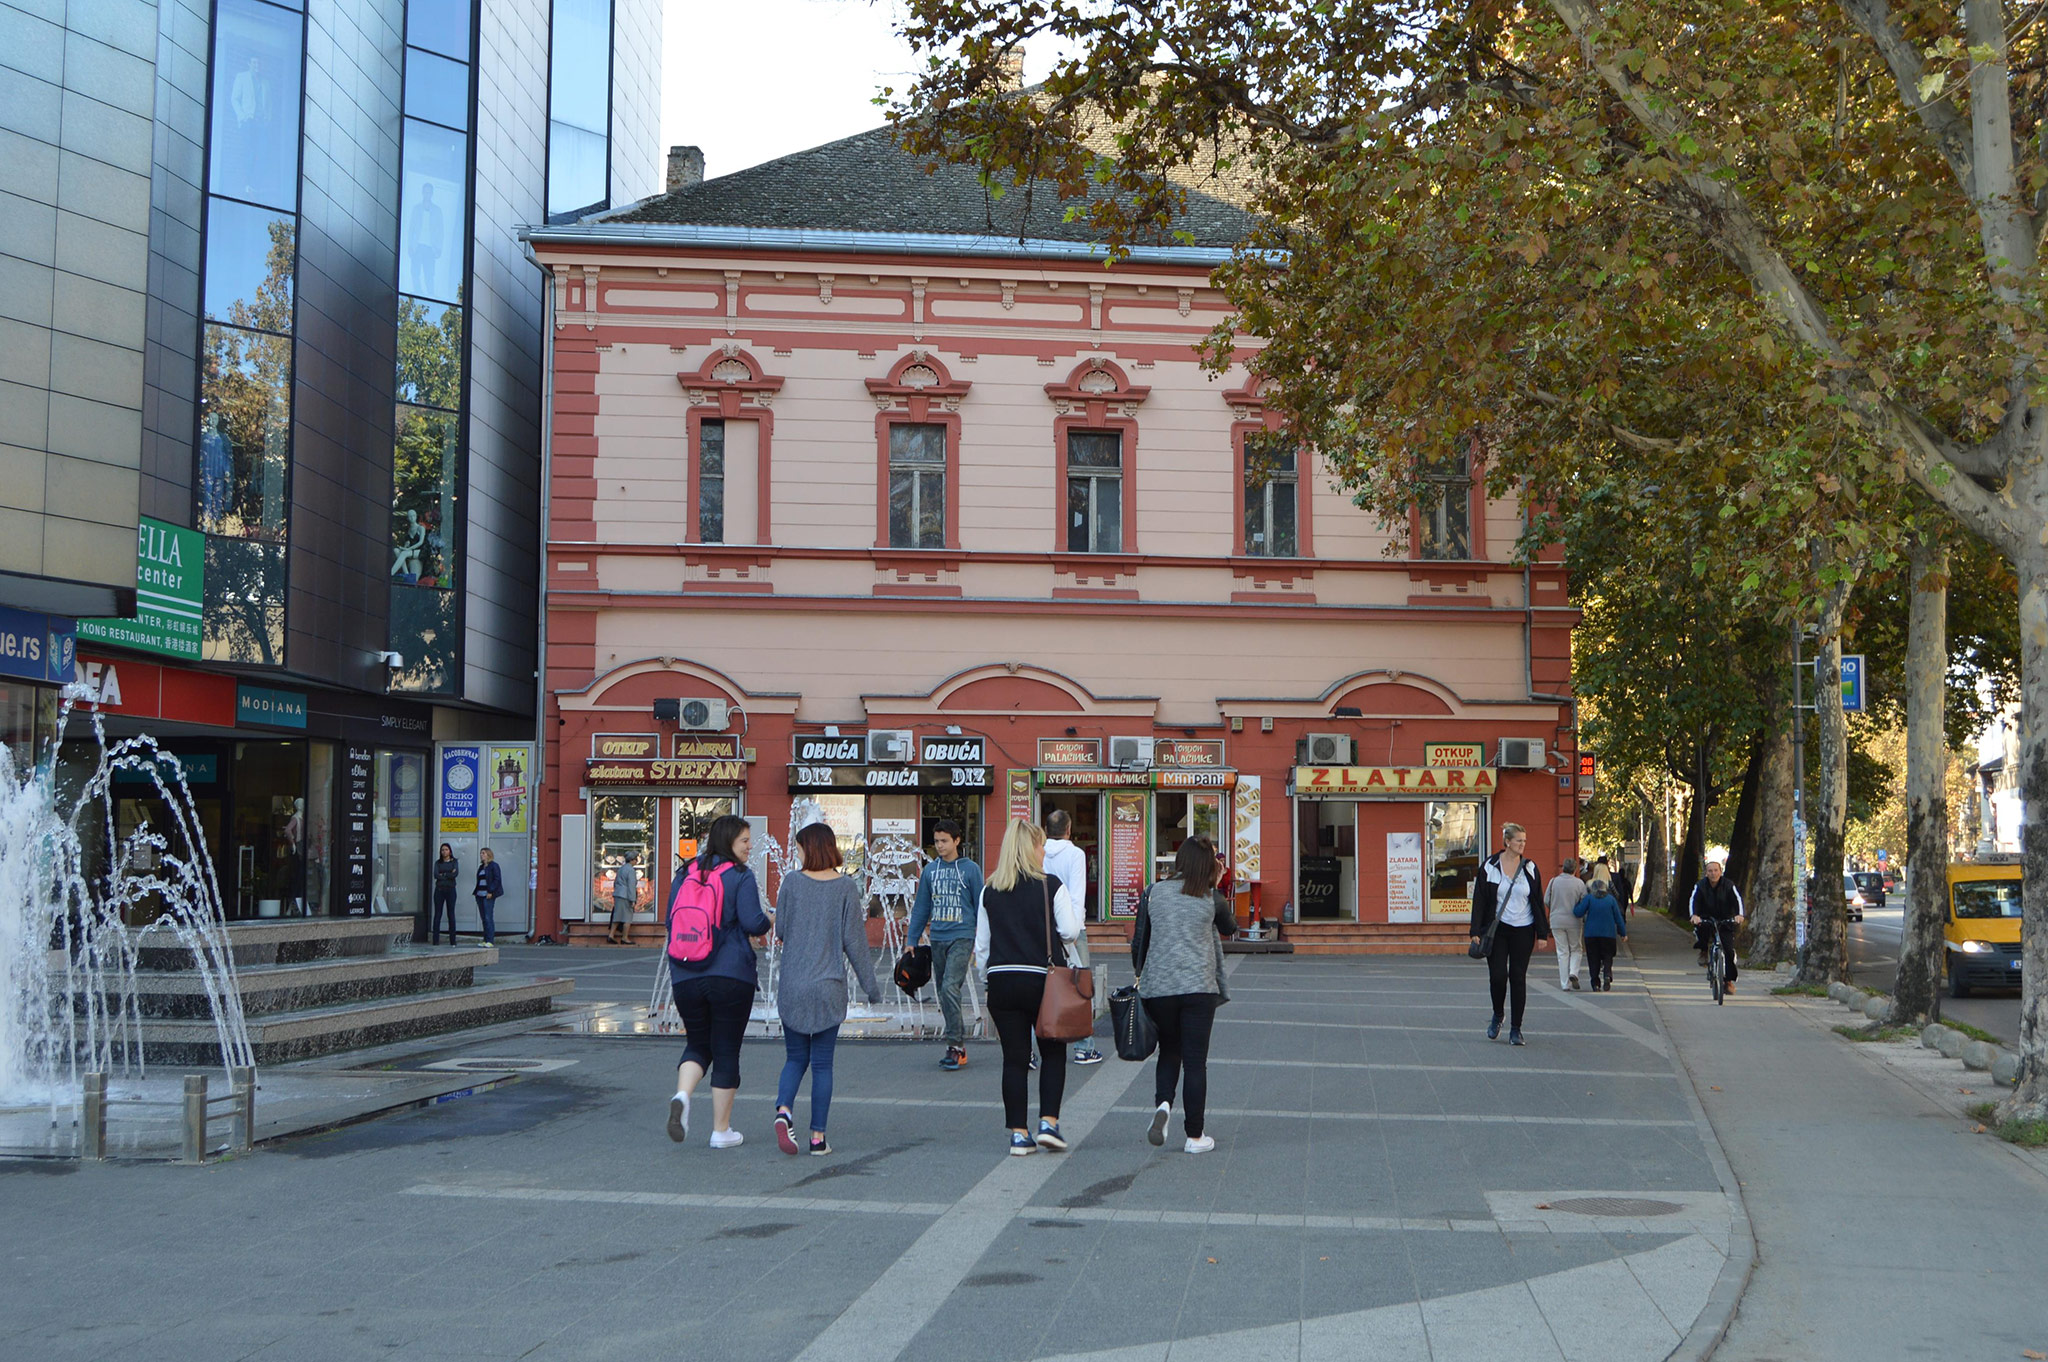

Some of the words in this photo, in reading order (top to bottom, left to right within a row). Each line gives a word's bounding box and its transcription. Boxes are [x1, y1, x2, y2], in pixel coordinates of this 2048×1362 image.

[138, 565, 182, 589] center
[82, 622, 107, 637] KONG
[109, 627, 163, 649] RESTAURANT,
[241, 695, 302, 715] MODIANA
[381, 715, 401, 729] SIMPLY
[402, 718, 427, 731] ELEGANT
[602, 742, 650, 755] OTKUP
[802, 740, 859, 759] OBUĆA
[924, 741, 980, 761] OBUĆA
[1056, 743, 1084, 753] LONDON
[1435, 748, 1473, 758] OTKUP
[589, 764, 645, 779] zlatara
[650, 761, 742, 779] STEFAN
[1432, 759, 1479, 767] ZAMENA
[797, 767, 833, 786] DIZ
[866, 768, 919, 786] OBUĆA
[951, 767, 985, 786] DIZ
[1311, 768, 1492, 786] ZLATARA
[352, 791, 366, 800] ONLY
[445, 792, 473, 800] SEIKO
[445, 808, 472, 816] Nivada
